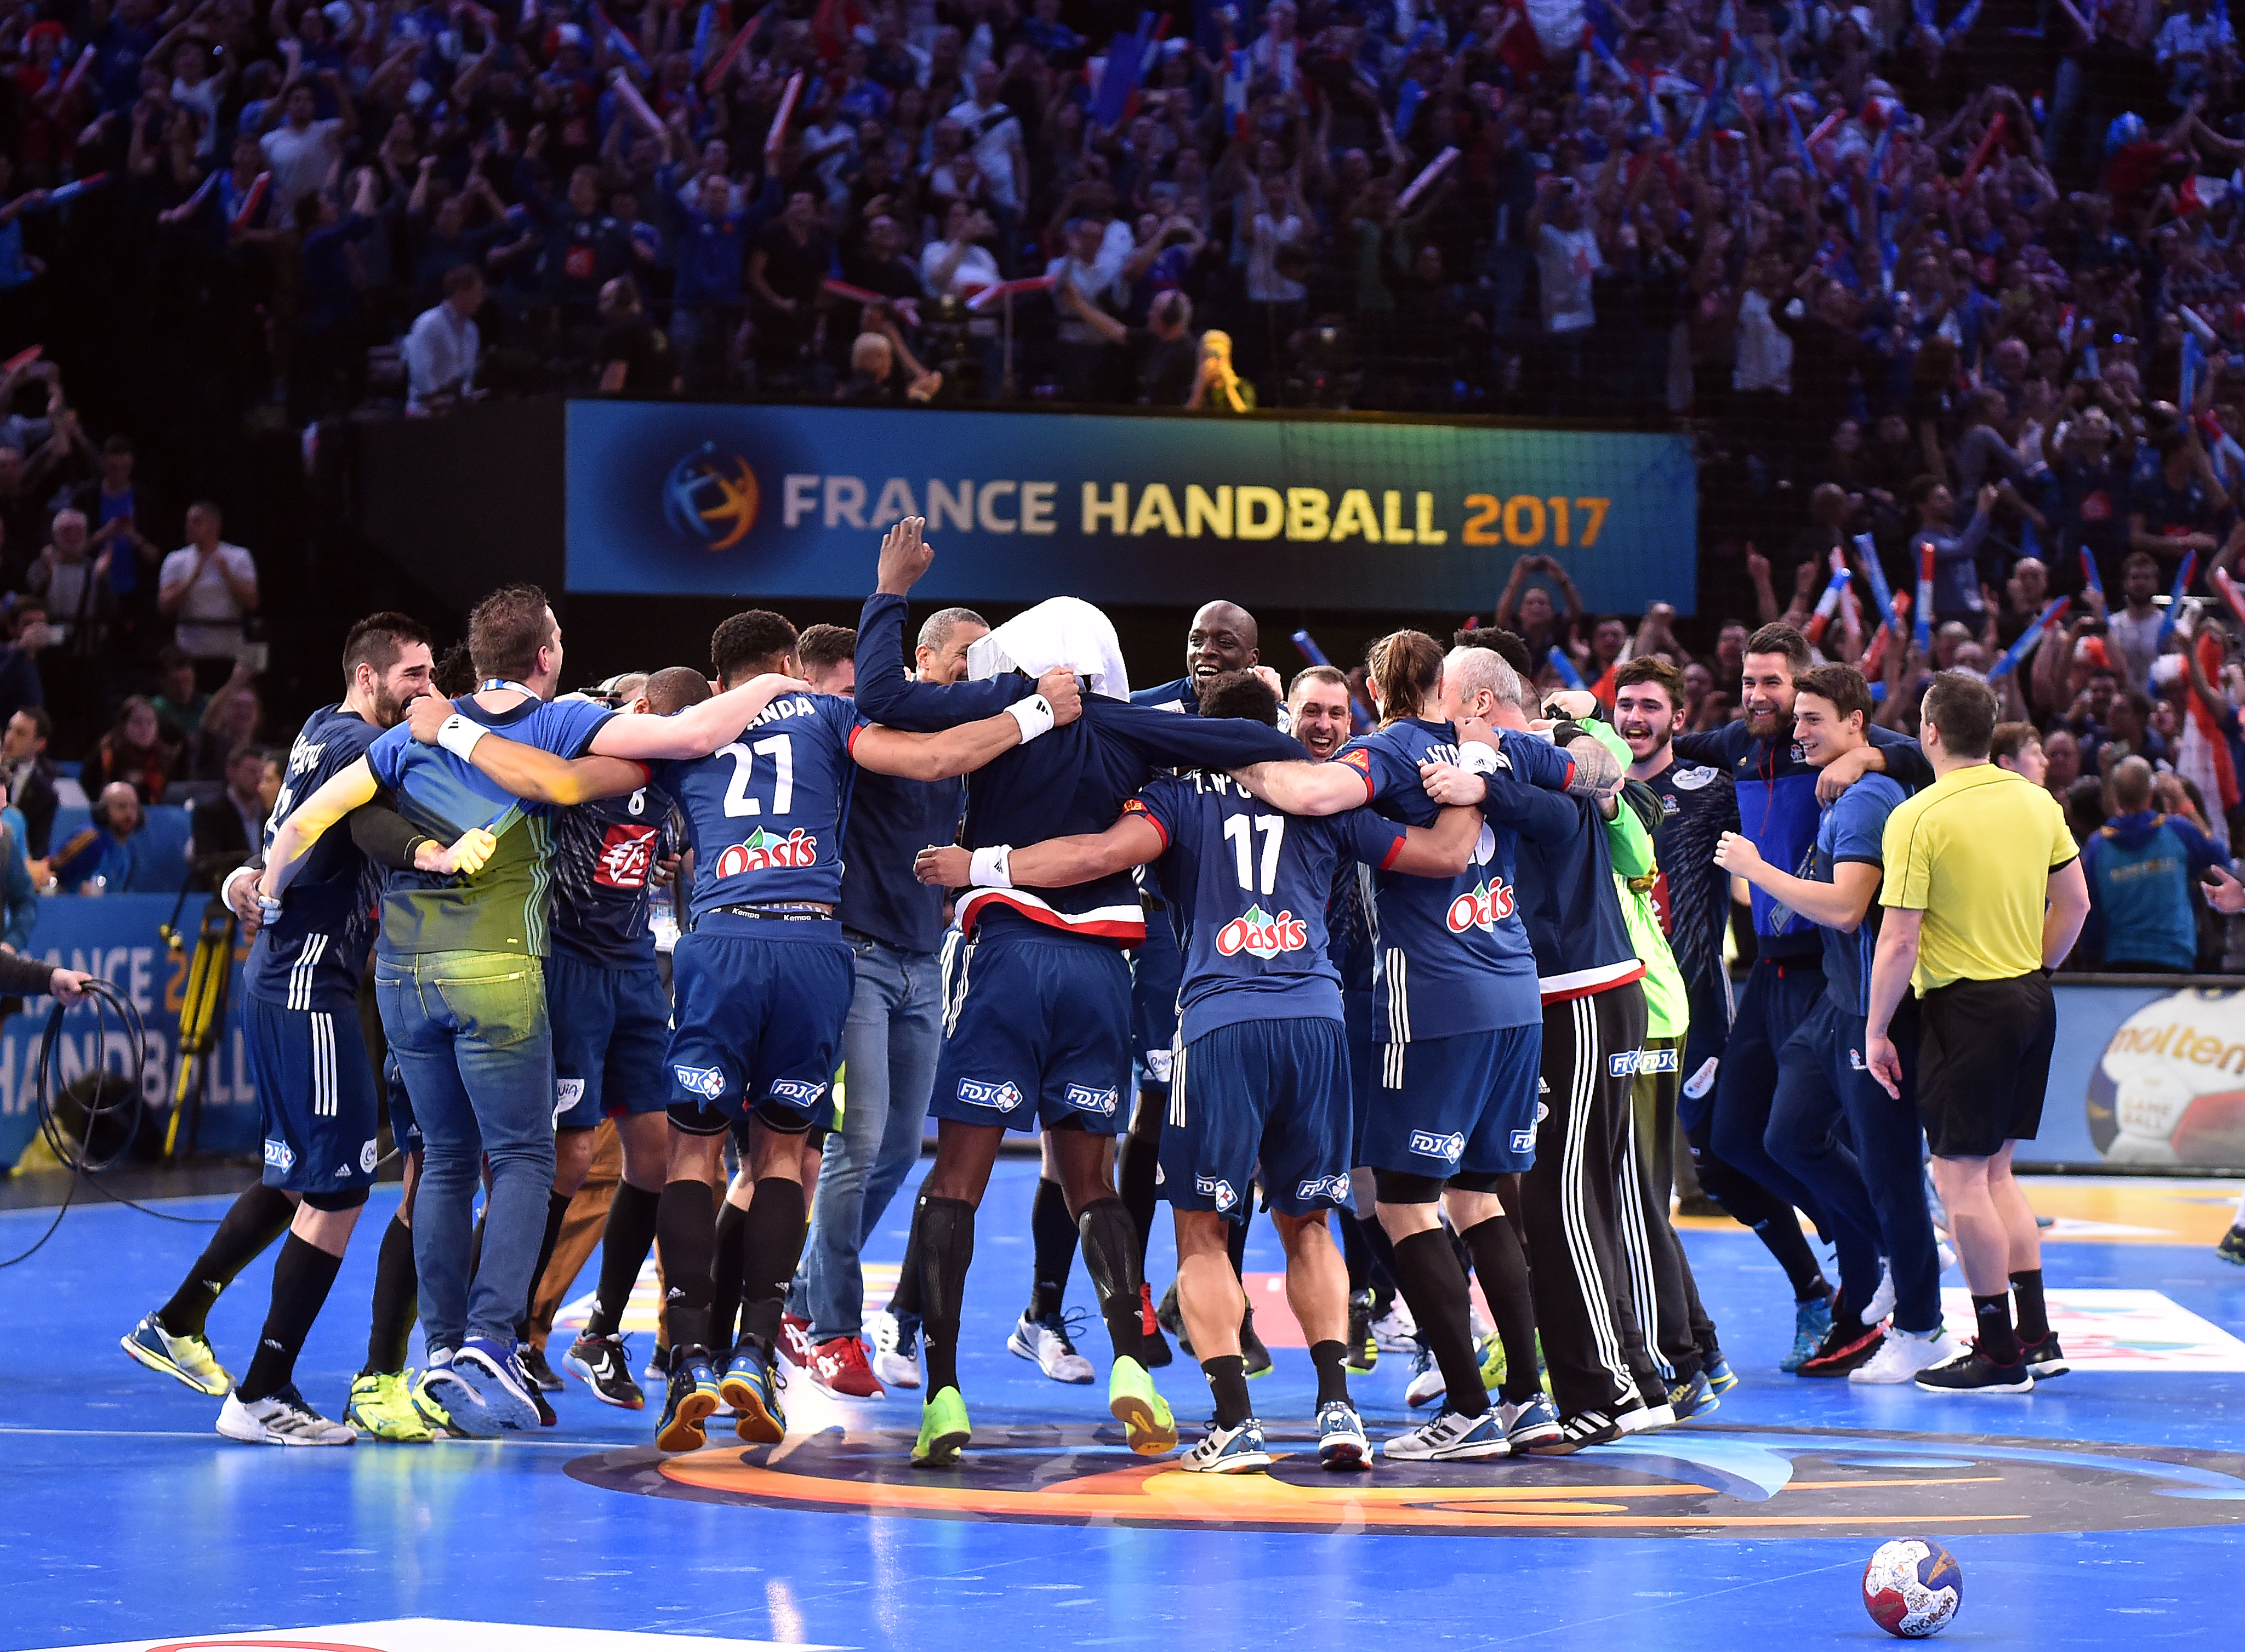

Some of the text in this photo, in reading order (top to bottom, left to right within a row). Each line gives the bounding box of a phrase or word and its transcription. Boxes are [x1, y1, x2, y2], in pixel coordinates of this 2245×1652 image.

[783, 474, 1610, 547] FRANCE HANDBALL 2017
[747, 697, 816, 730] ANDA
[714, 733, 794, 818] 27
[717, 828, 817, 879] Oasis
[1223, 813, 1284, 895] 17
[1217, 911, 1307, 955] Oasis
[1643, 1053, 1668, 1069] FDJ
[2111, 1022, 2245, 1075] molten
[678, 1070, 699, 1086] FDJ
[773, 1083, 806, 1098] FDJ
[960, 1083, 993, 1101] FDJ
[1067, 1090, 1099, 1107] FDJ
[265, 1143, 280, 1160] DJ
[1411, 1134, 1443, 1152] FDJ
[1196, 1178, 1214, 1192] FD
[1904, 1596, 1954, 1634] molten
